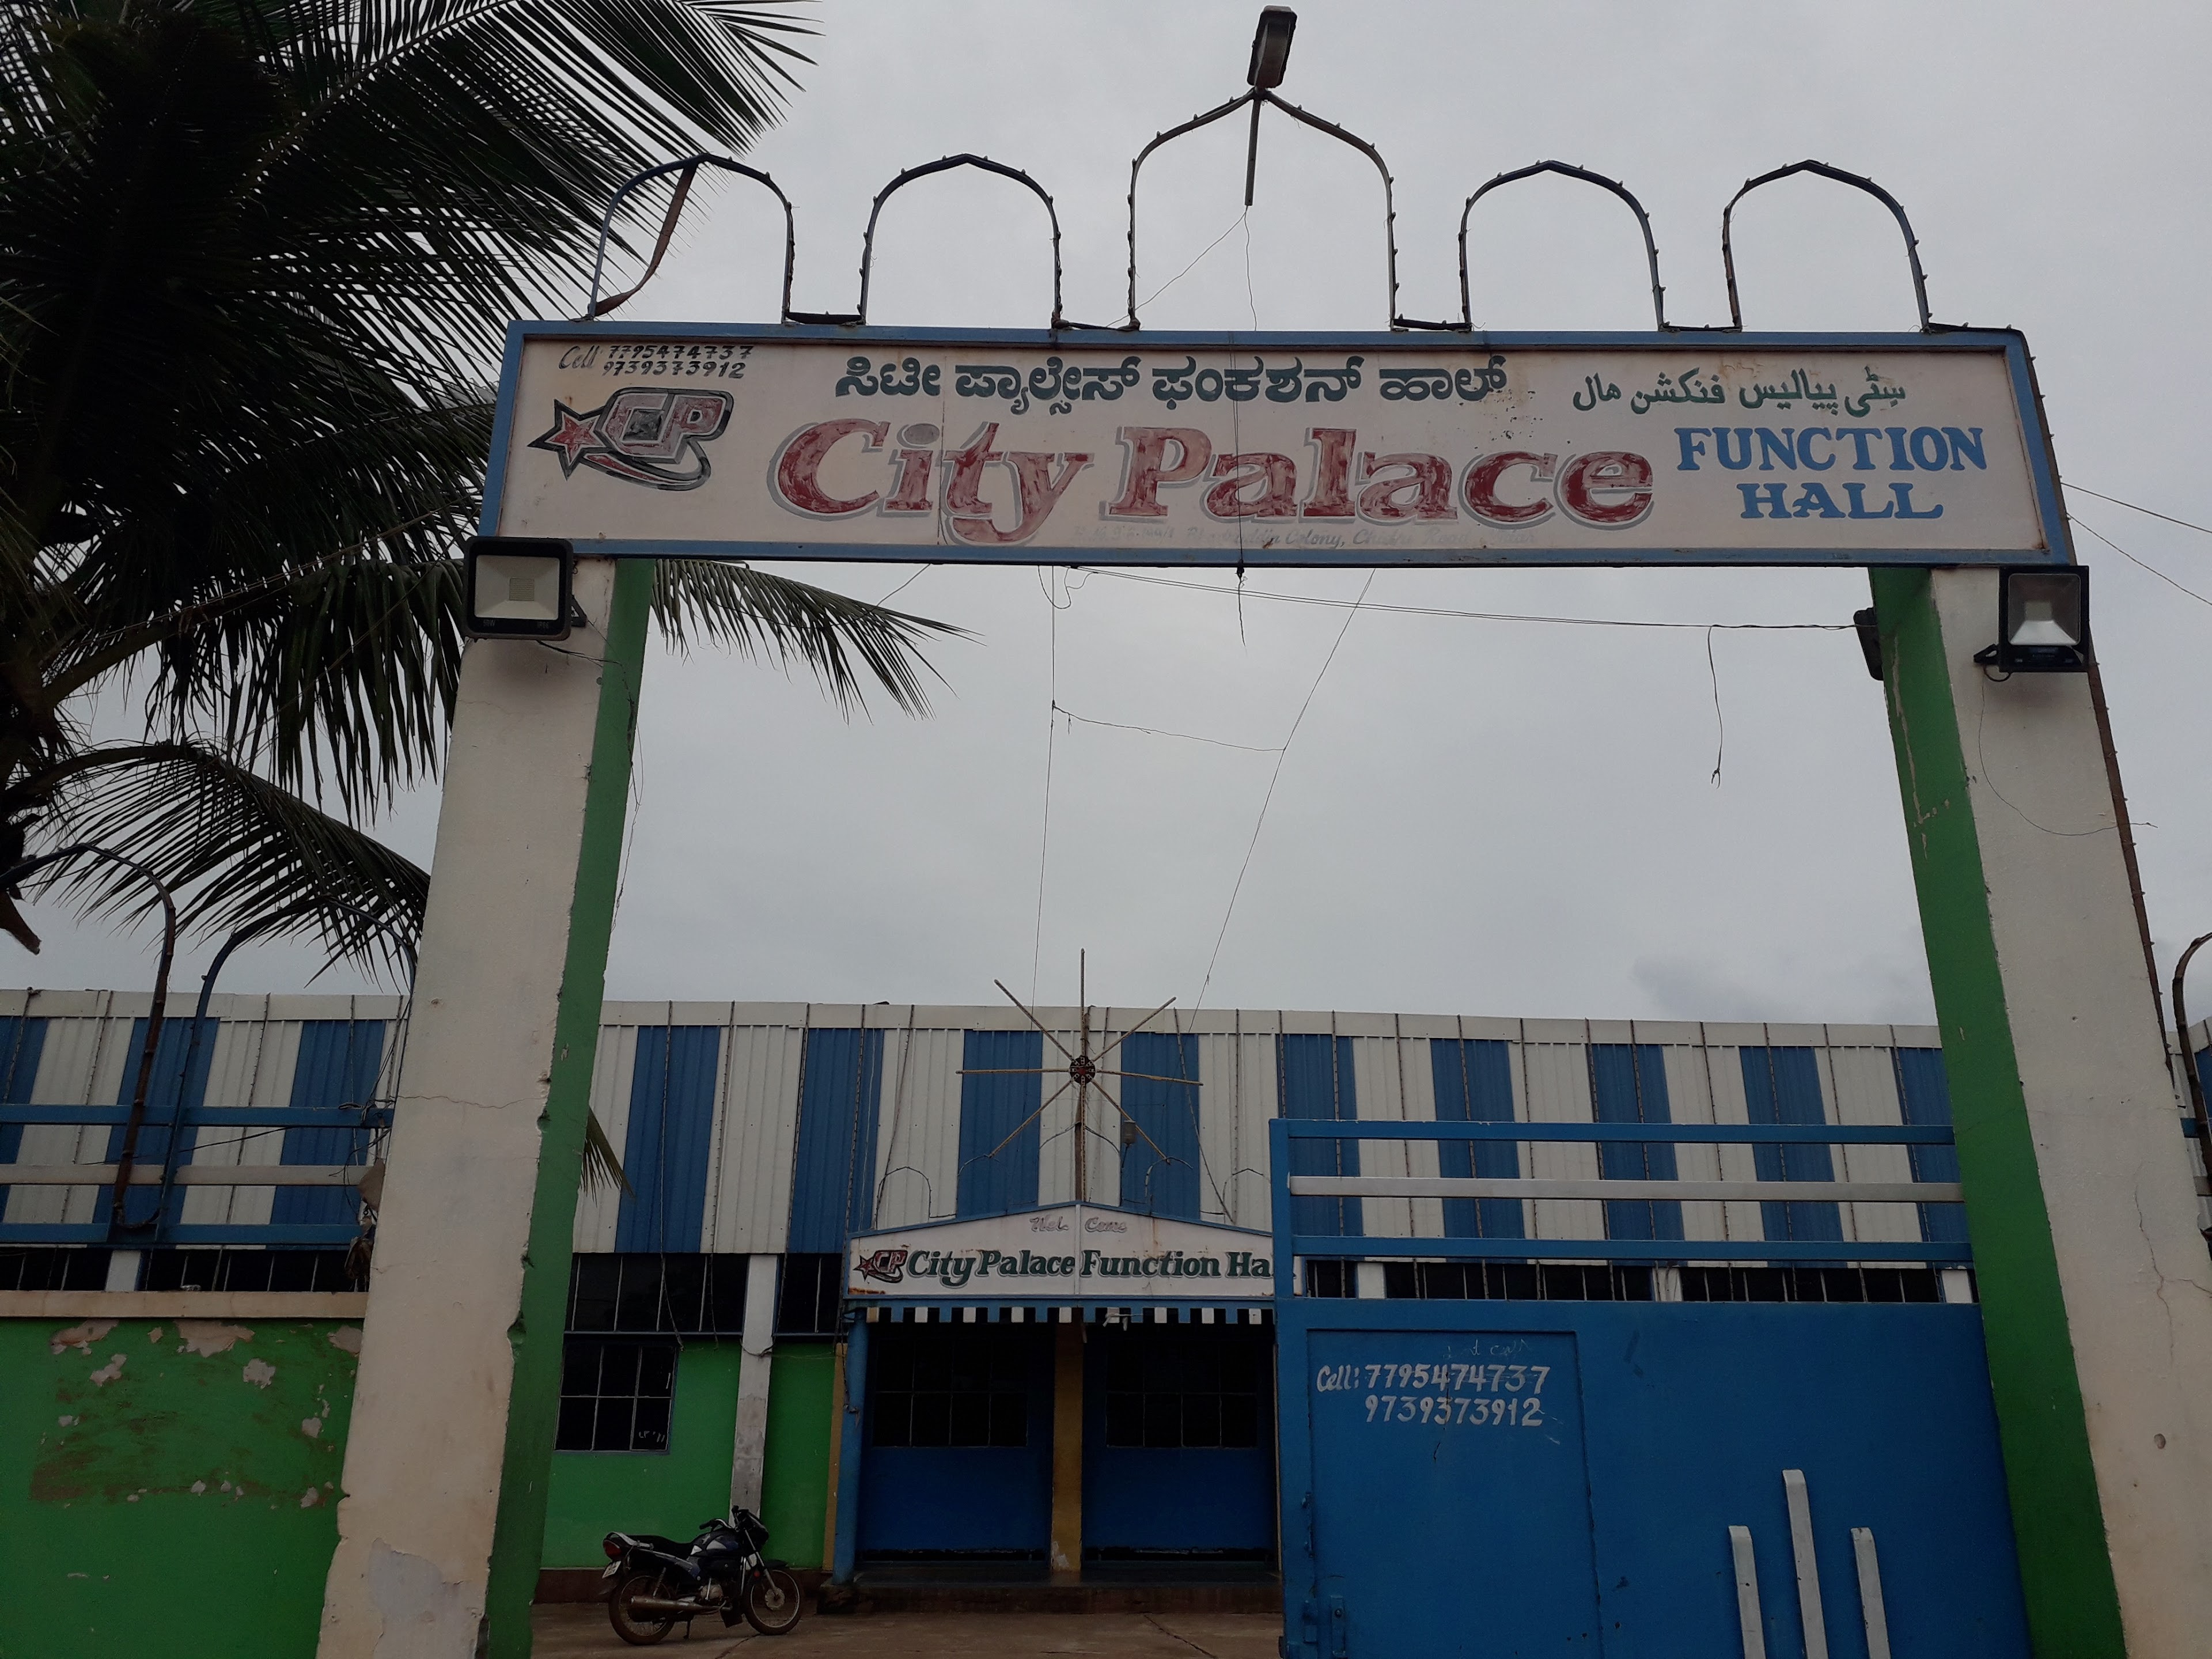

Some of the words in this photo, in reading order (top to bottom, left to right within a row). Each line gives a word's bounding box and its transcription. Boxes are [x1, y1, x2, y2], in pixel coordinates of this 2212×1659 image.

[603, 361, 747, 378] 9739373912
[608, 345, 753, 359] 7795474737
[1379, 355, 1507, 402] ಹಾಲ್
[1673, 426, 1988, 472] FUNCTION
[767, 419, 1094, 545] City
[1099, 425, 1655, 531] Palace
[1736, 482, 1944, 520] HALL
[907, 1249, 976, 1289] City
[975, 1249, 1075, 1277] Palace
[1080, 1249, 1222, 1278] Function
[1225, 1251, 1274, 1278] Ha
[1316, 1365, 1361, 1392] Cell:
[1364, 1363, 1551, 1395] 7795474737
[1365, 1394, 1543, 1427] 9739373912
